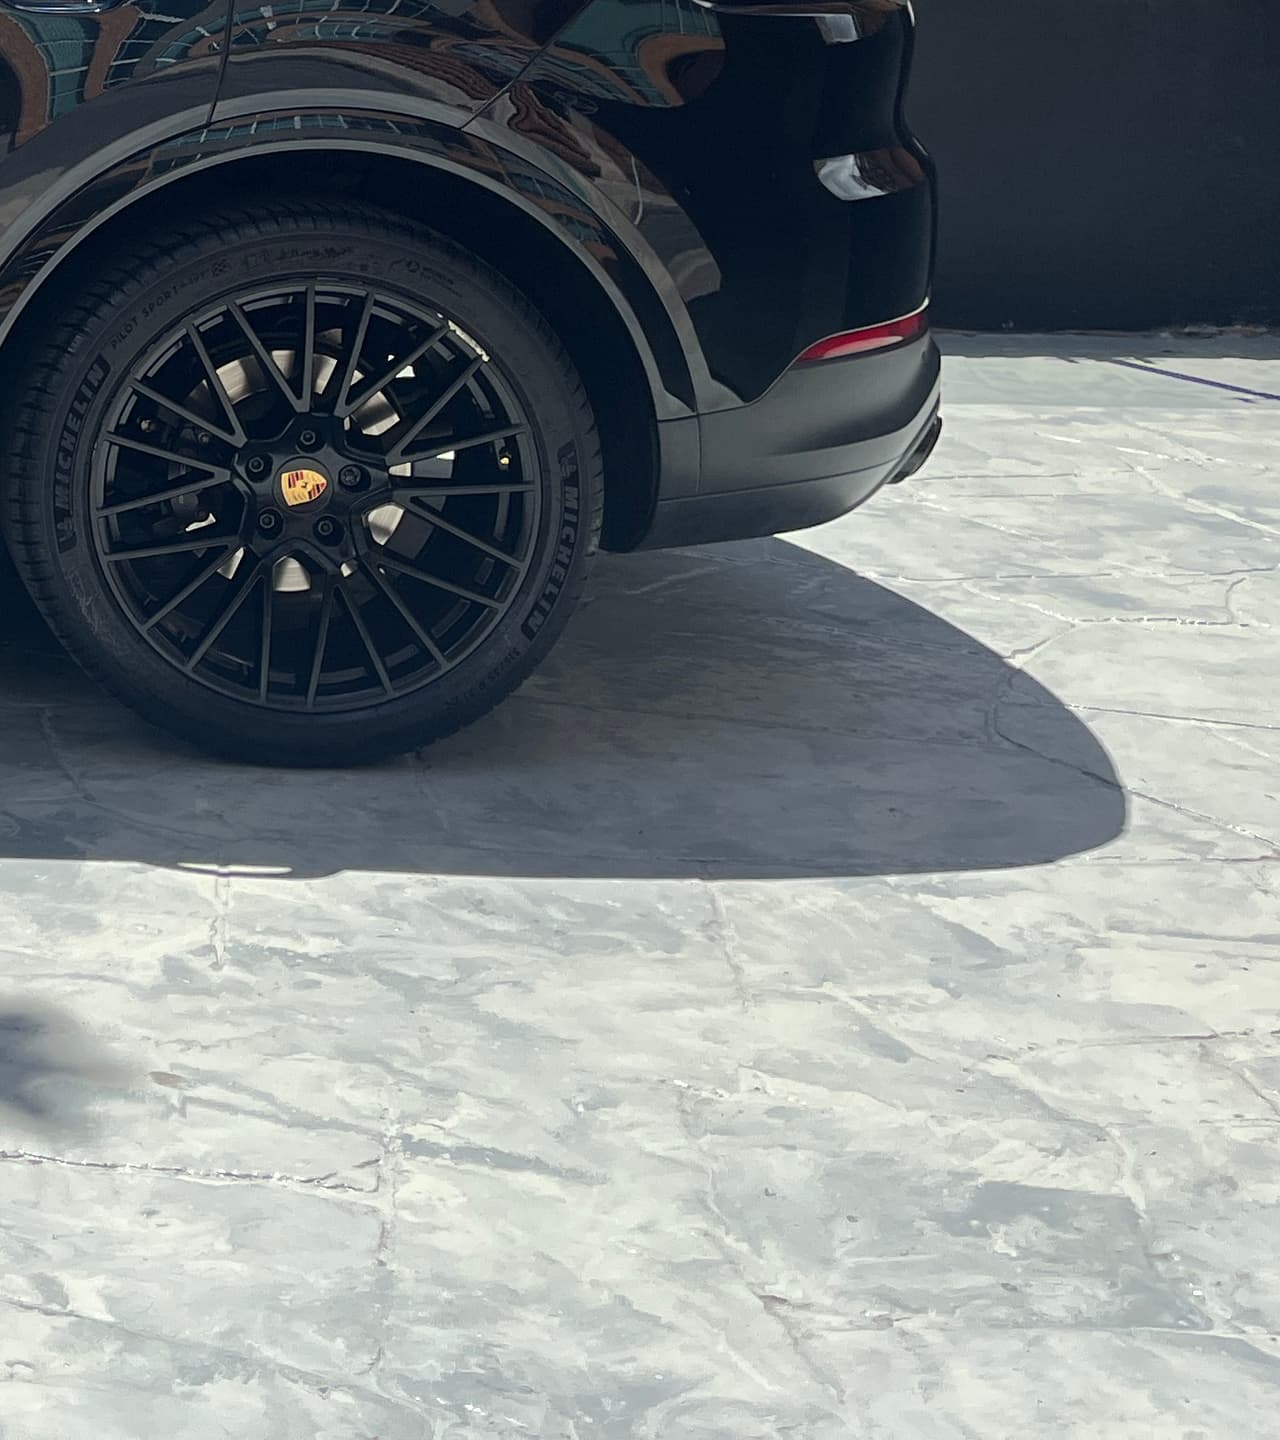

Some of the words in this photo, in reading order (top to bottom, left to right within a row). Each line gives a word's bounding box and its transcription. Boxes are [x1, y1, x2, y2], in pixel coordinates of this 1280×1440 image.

[110, 316, 139, 350] PILOT
[142, 285, 178, 318] SPORT
[54, 361, 106, 507] MICHELIN
[526, 485, 580, 633] MICHELIN
